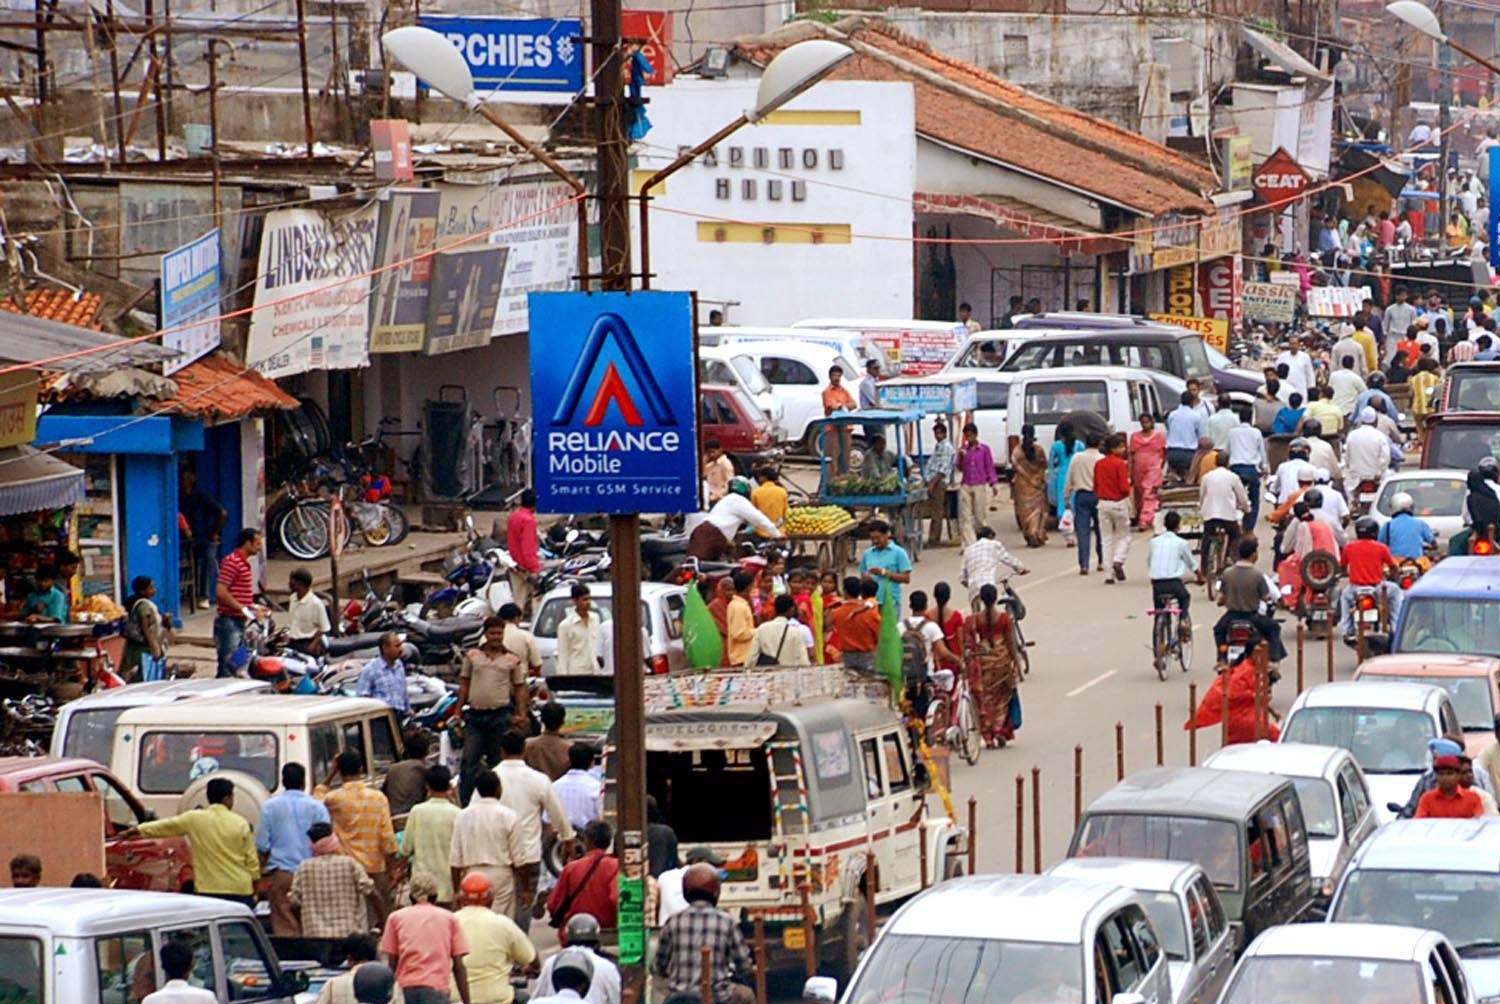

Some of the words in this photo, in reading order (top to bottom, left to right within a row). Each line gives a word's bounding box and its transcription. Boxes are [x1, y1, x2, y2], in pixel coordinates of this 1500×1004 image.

[446, 33, 552, 67] RCHIES
[678, 145, 842, 170] CAPITOL
[716, 178, 805, 202] HILL
[1254, 174, 1300, 189] CEAT
[550, 454, 622, 473] Mobile
[551, 484, 591, 494] Smart
[597, 484, 627, 494] GSM
[632, 484, 682, 494] Service
